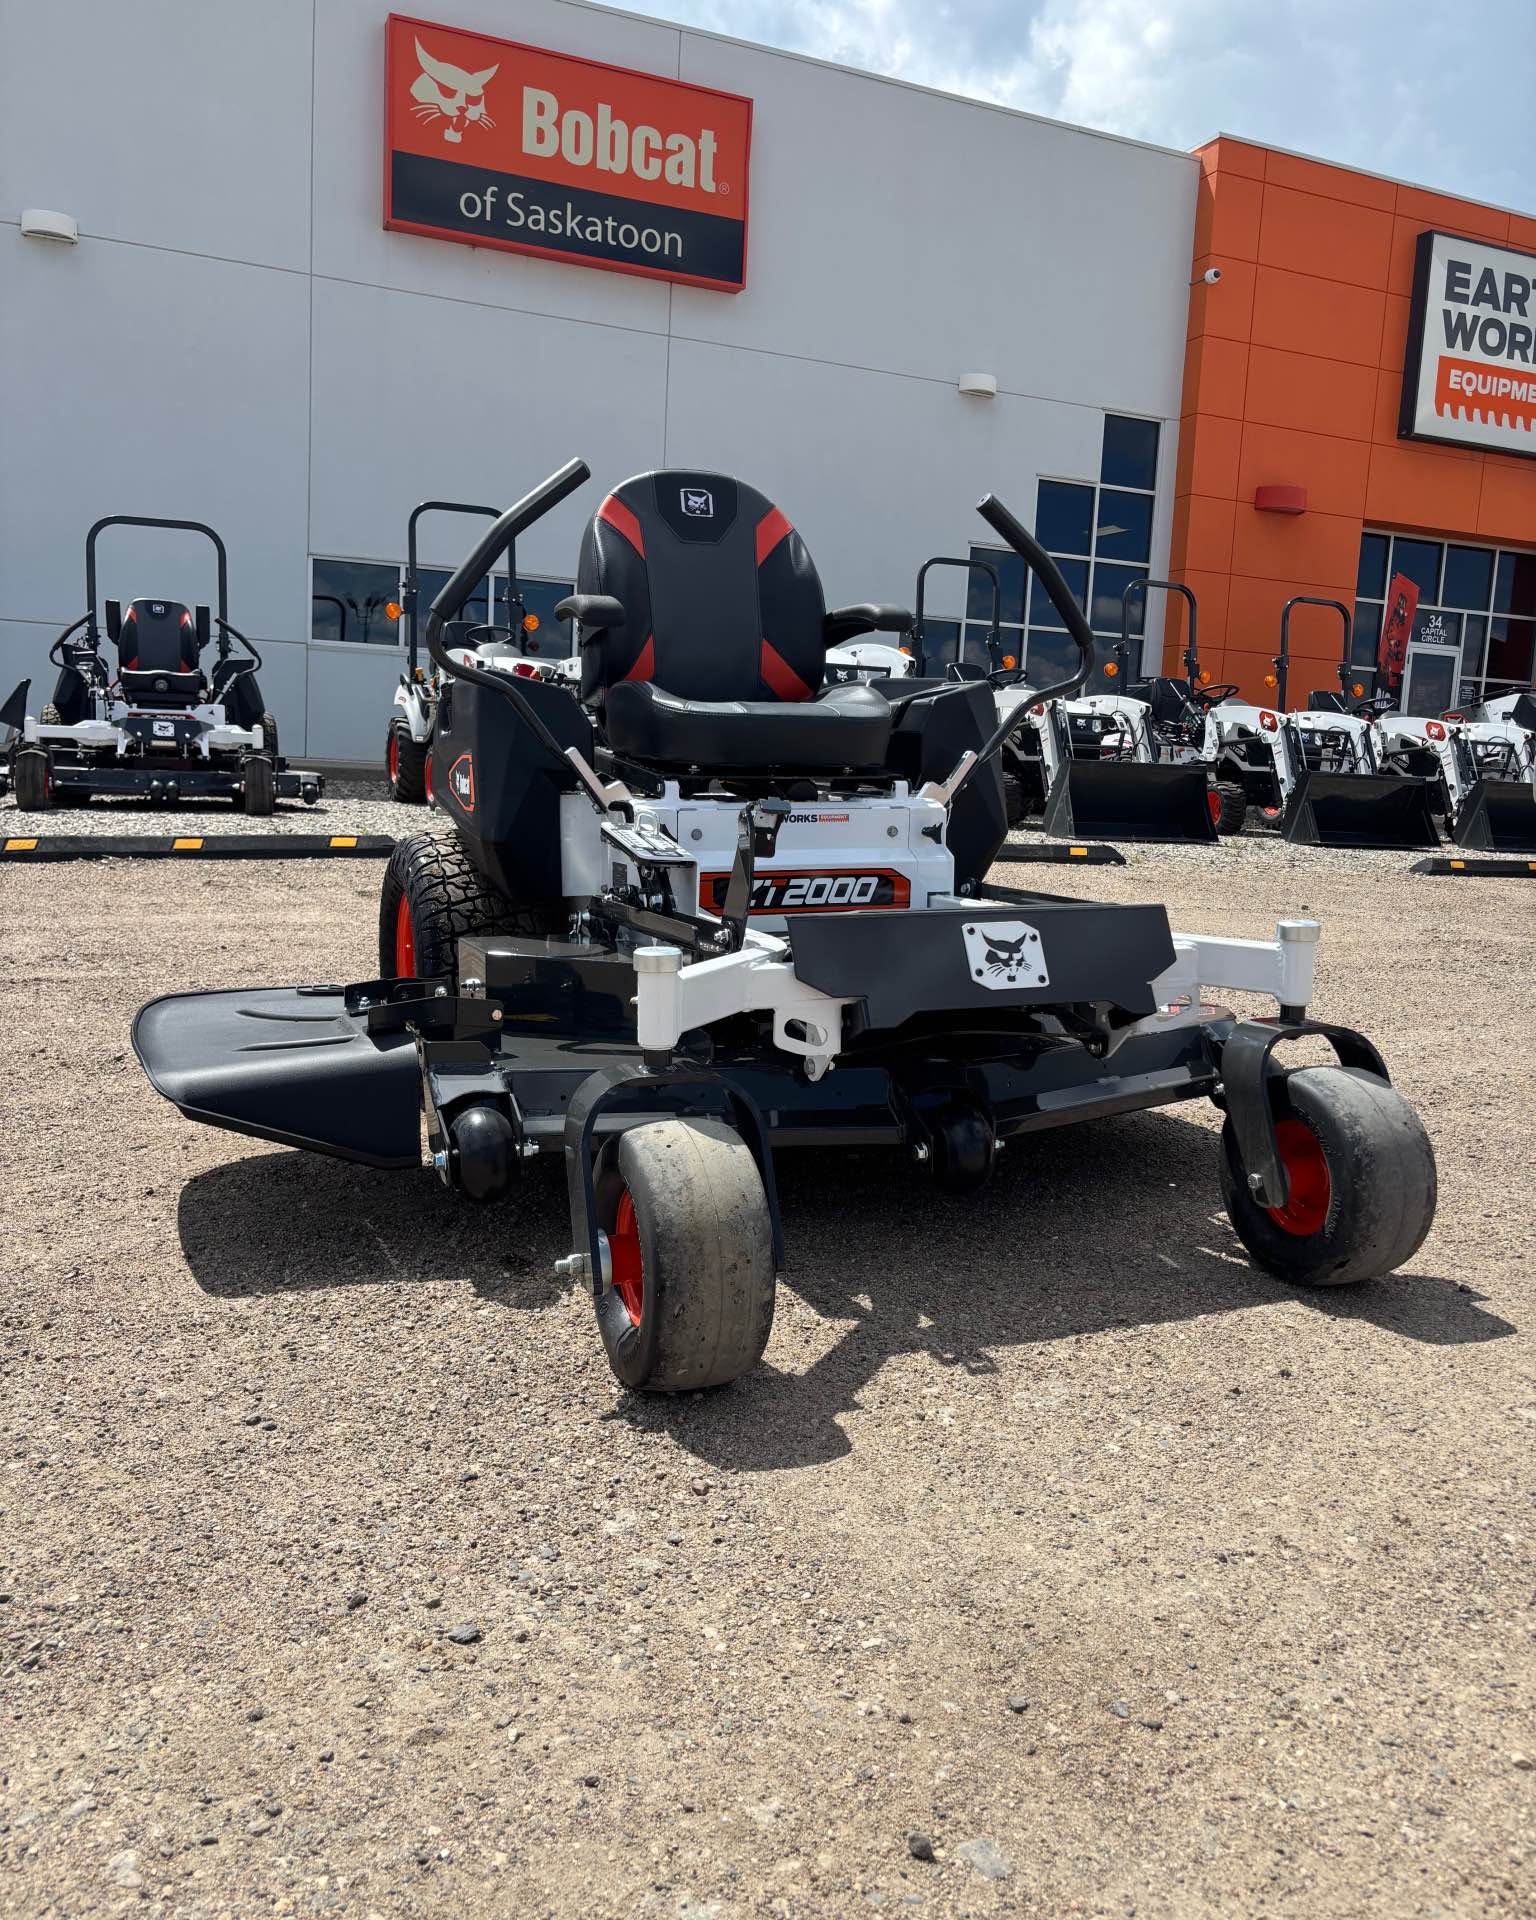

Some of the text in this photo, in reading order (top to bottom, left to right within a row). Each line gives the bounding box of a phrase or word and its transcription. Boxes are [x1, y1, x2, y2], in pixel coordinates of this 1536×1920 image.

[522, 86, 717, 192] Bobcat
[459, 186, 683, 258] of Saskatoon
[1445, 259, 1536, 317] EAR
[1442, 309, 1536, 364] WOR
[1420, 627, 1448, 637] CAPITAL
[1421, 635, 1445, 643] CIRCLE
[1429, 615, 1442, 628] 34
